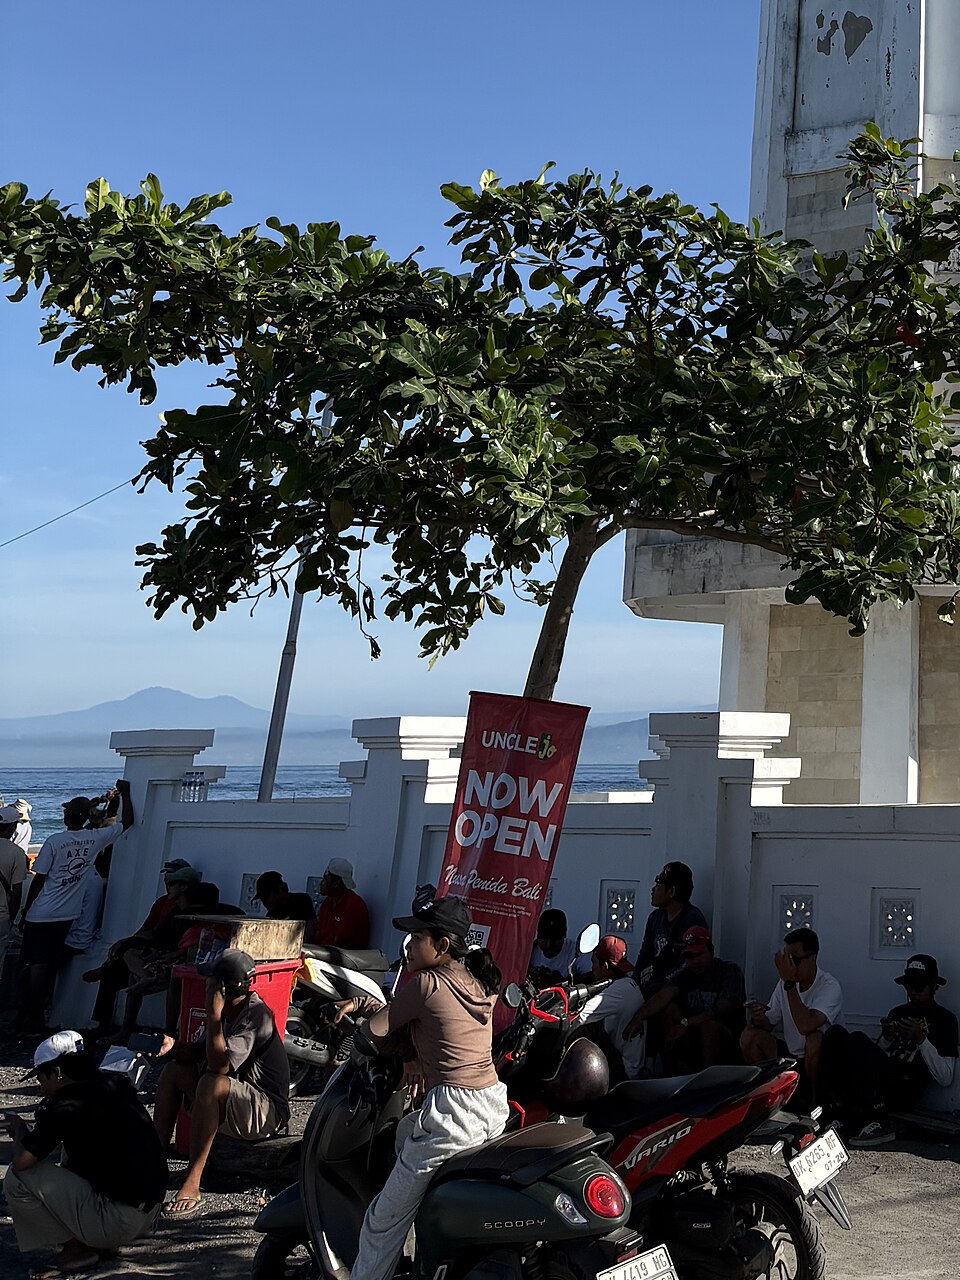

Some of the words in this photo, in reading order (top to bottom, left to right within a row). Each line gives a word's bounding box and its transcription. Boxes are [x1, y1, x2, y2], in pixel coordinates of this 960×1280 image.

[481, 730, 539, 754] UNCLE
[463, 769, 564, 818] NOW
[454, 809, 557, 861] OPEN
[66, 848, 89, 859] AXE
[444, 864, 467, 886] Nusa
[464, 869, 508, 894] Penida
[512, 877, 543, 900] Bali
[624, 1125, 691, 1170] VARIO
[804, 1144, 825, 1167] 6265
[484, 1219, 546, 1230] SCOOPY
